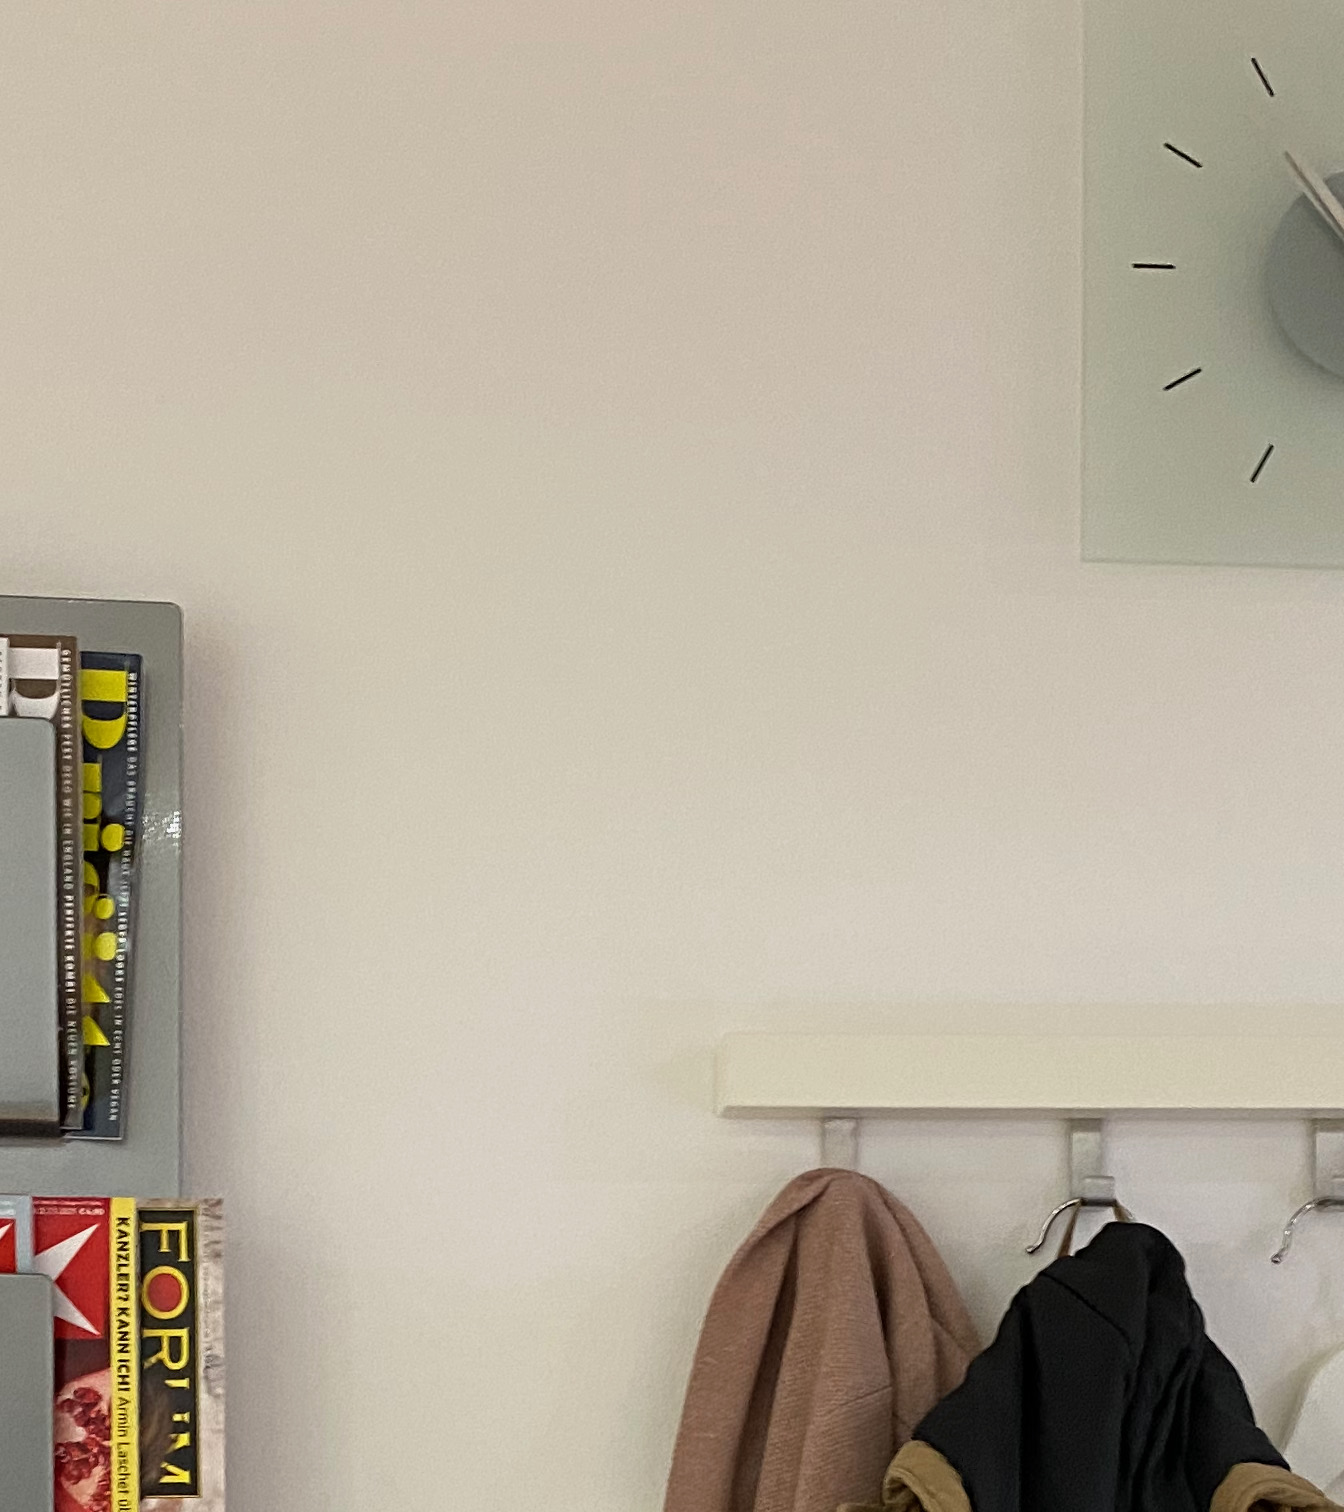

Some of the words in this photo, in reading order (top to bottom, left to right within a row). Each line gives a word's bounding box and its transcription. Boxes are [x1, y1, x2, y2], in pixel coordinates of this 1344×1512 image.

[117, 1217, 132, 1301] KANZLER?
[117, 1307, 132, 1354] KANN
[140, 1220, 191, 1485] FOR
[117, 1397, 133, 1438] Armin
[117, 1442, 133, 1494] Laschet
